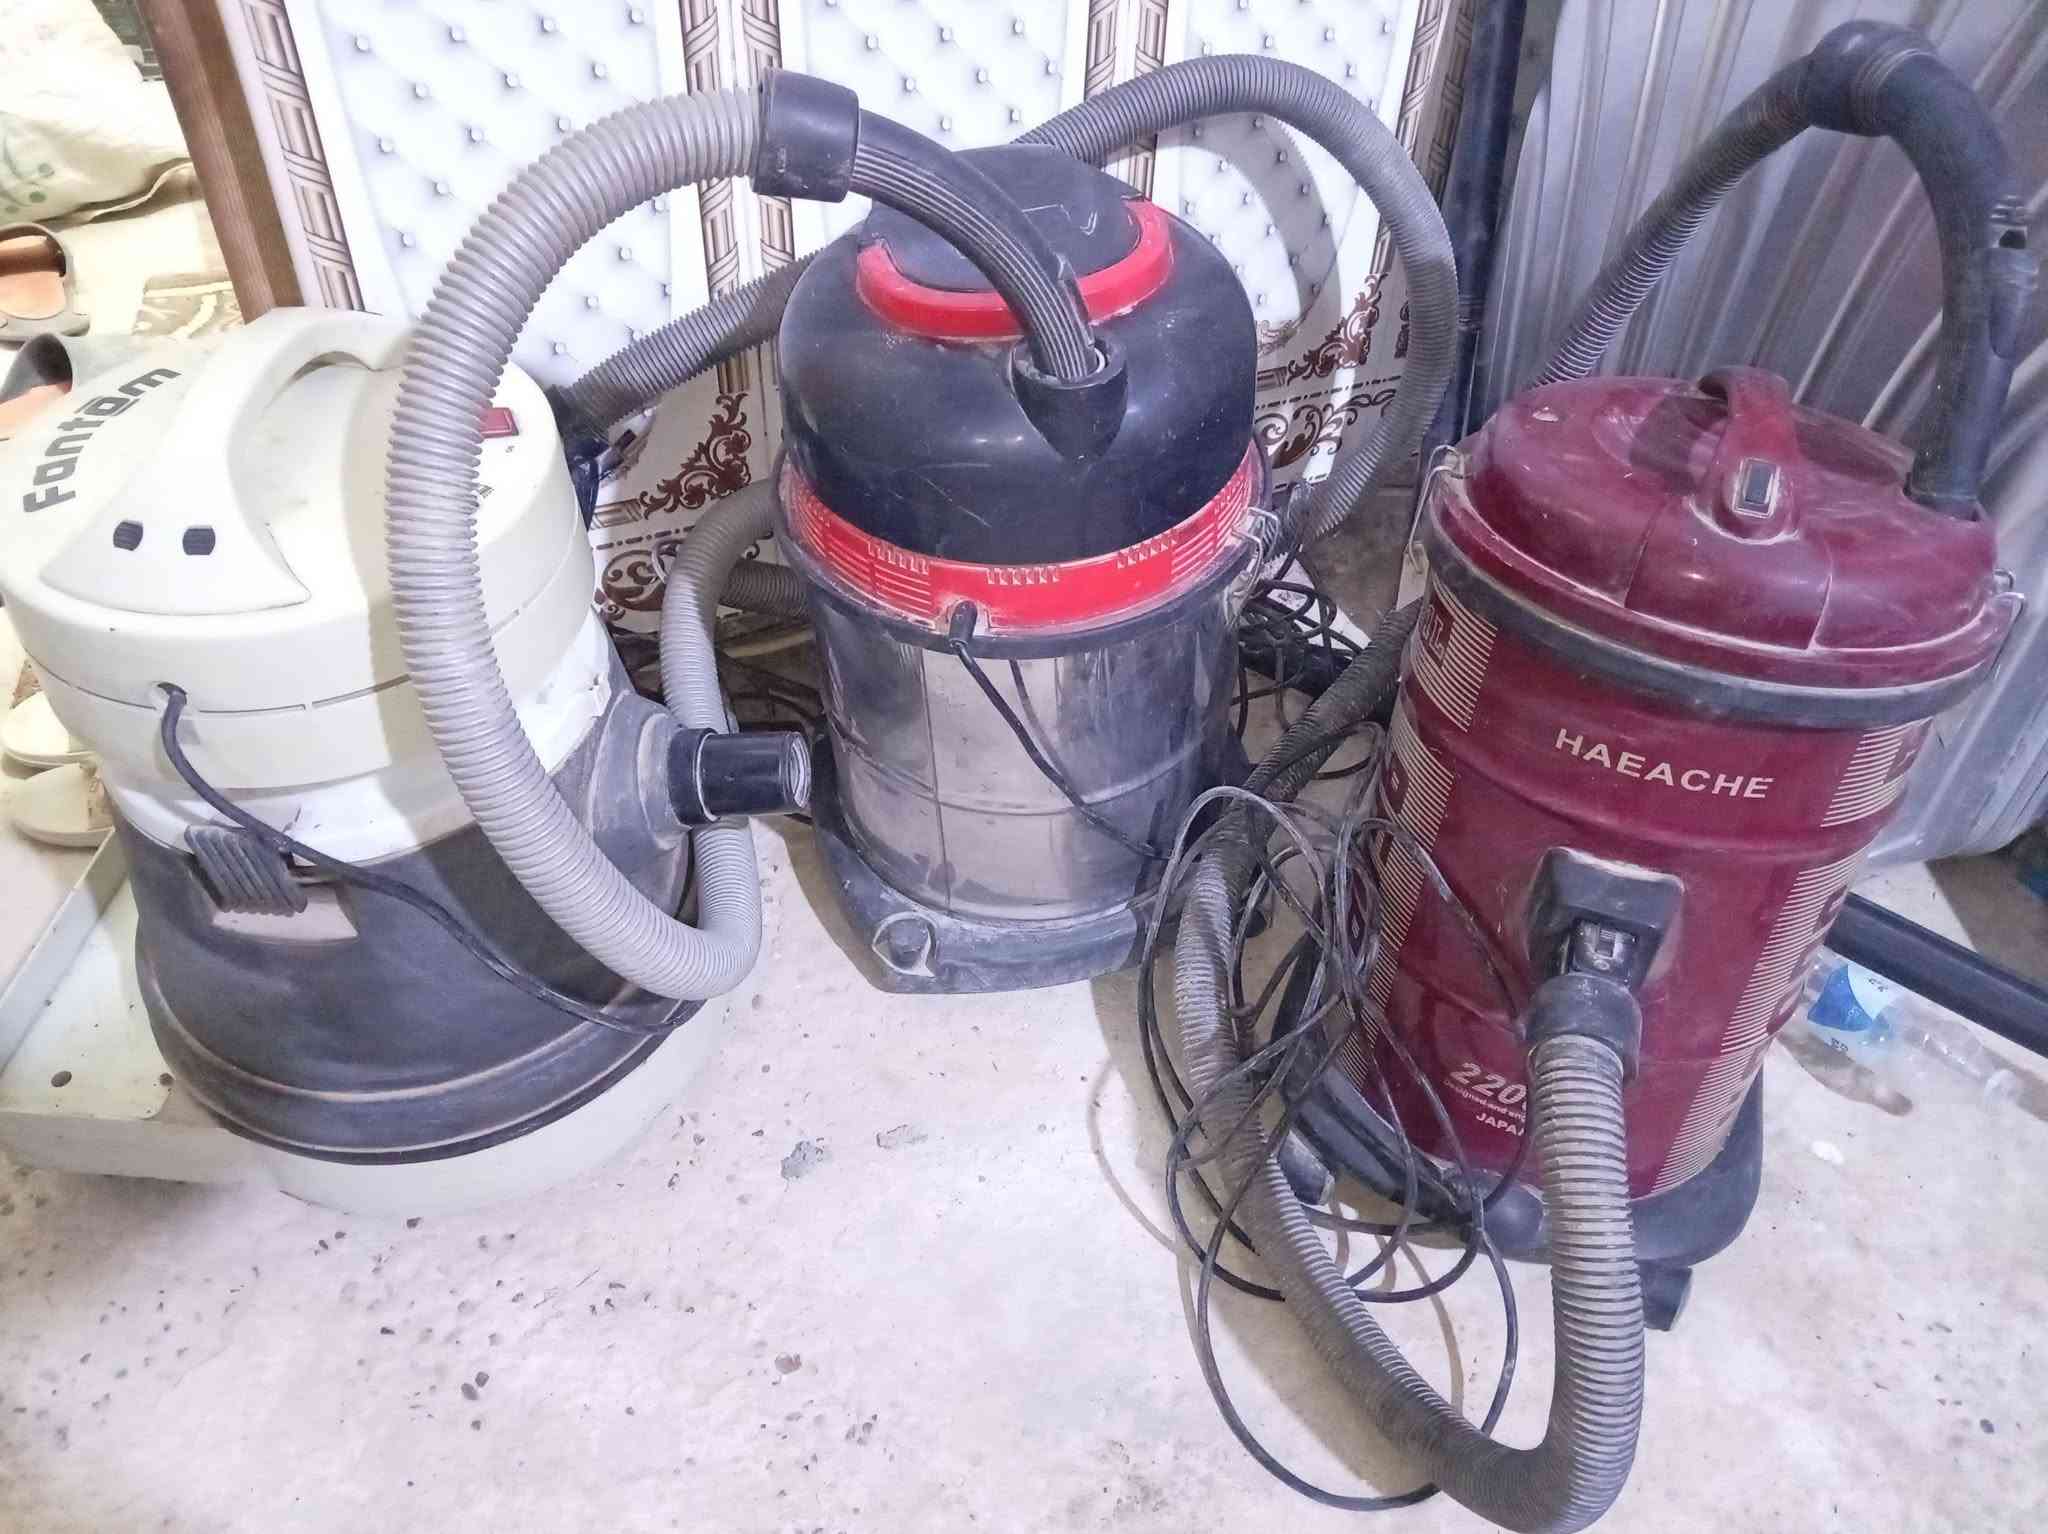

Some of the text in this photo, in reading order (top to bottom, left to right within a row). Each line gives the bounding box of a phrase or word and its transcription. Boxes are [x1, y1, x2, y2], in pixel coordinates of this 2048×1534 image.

[22, 368, 182, 513] Fantom
[1554, 727, 1775, 799] HAEACHE
[1449, 1062, 1527, 1111] 220
